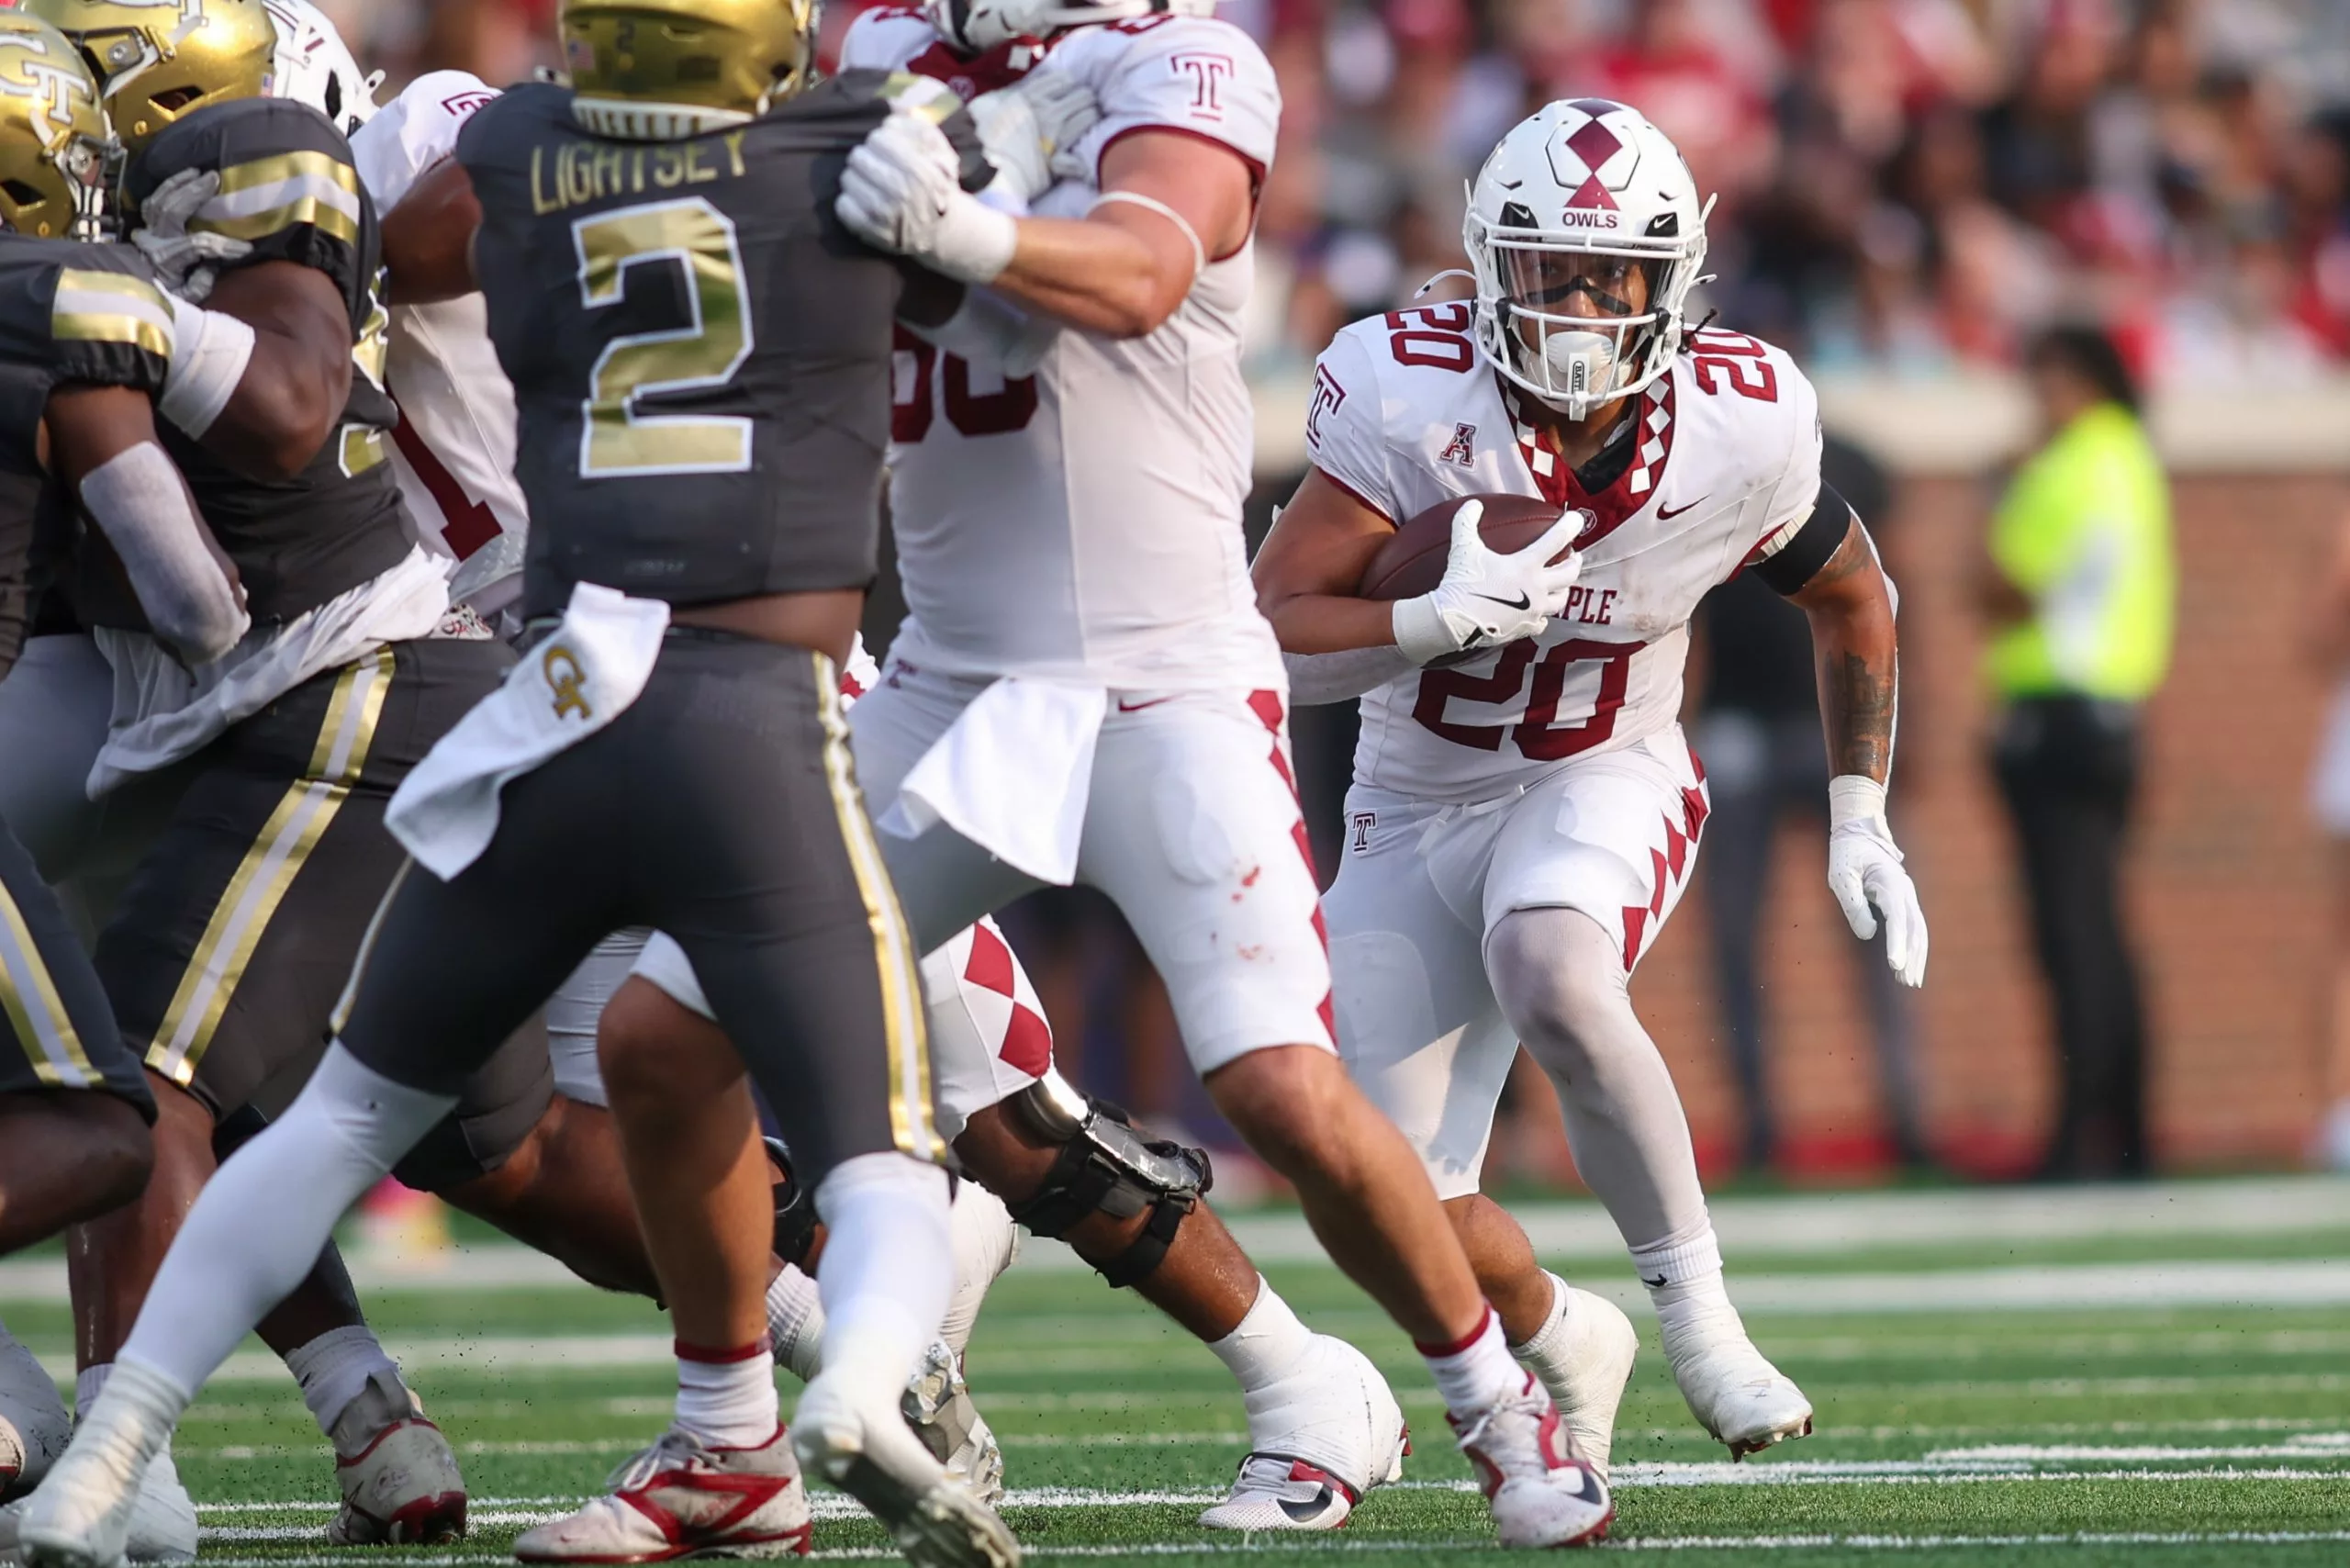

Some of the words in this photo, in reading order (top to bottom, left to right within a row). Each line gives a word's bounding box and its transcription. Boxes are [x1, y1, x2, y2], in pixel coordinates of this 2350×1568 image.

[1171, 52, 1234, 121] T
[531, 130, 746, 215] LIGHTSEY
[1562, 212, 1617, 229] OWLS
[571, 196, 755, 478] 2
[1384, 304, 1474, 374] 20
[1683, 330, 1778, 403] 20
[1440, 422, 1476, 467] A
[1552, 585, 1617, 625] PLE
[1412, 635, 1649, 761] 20
[1353, 812, 1376, 852] T
